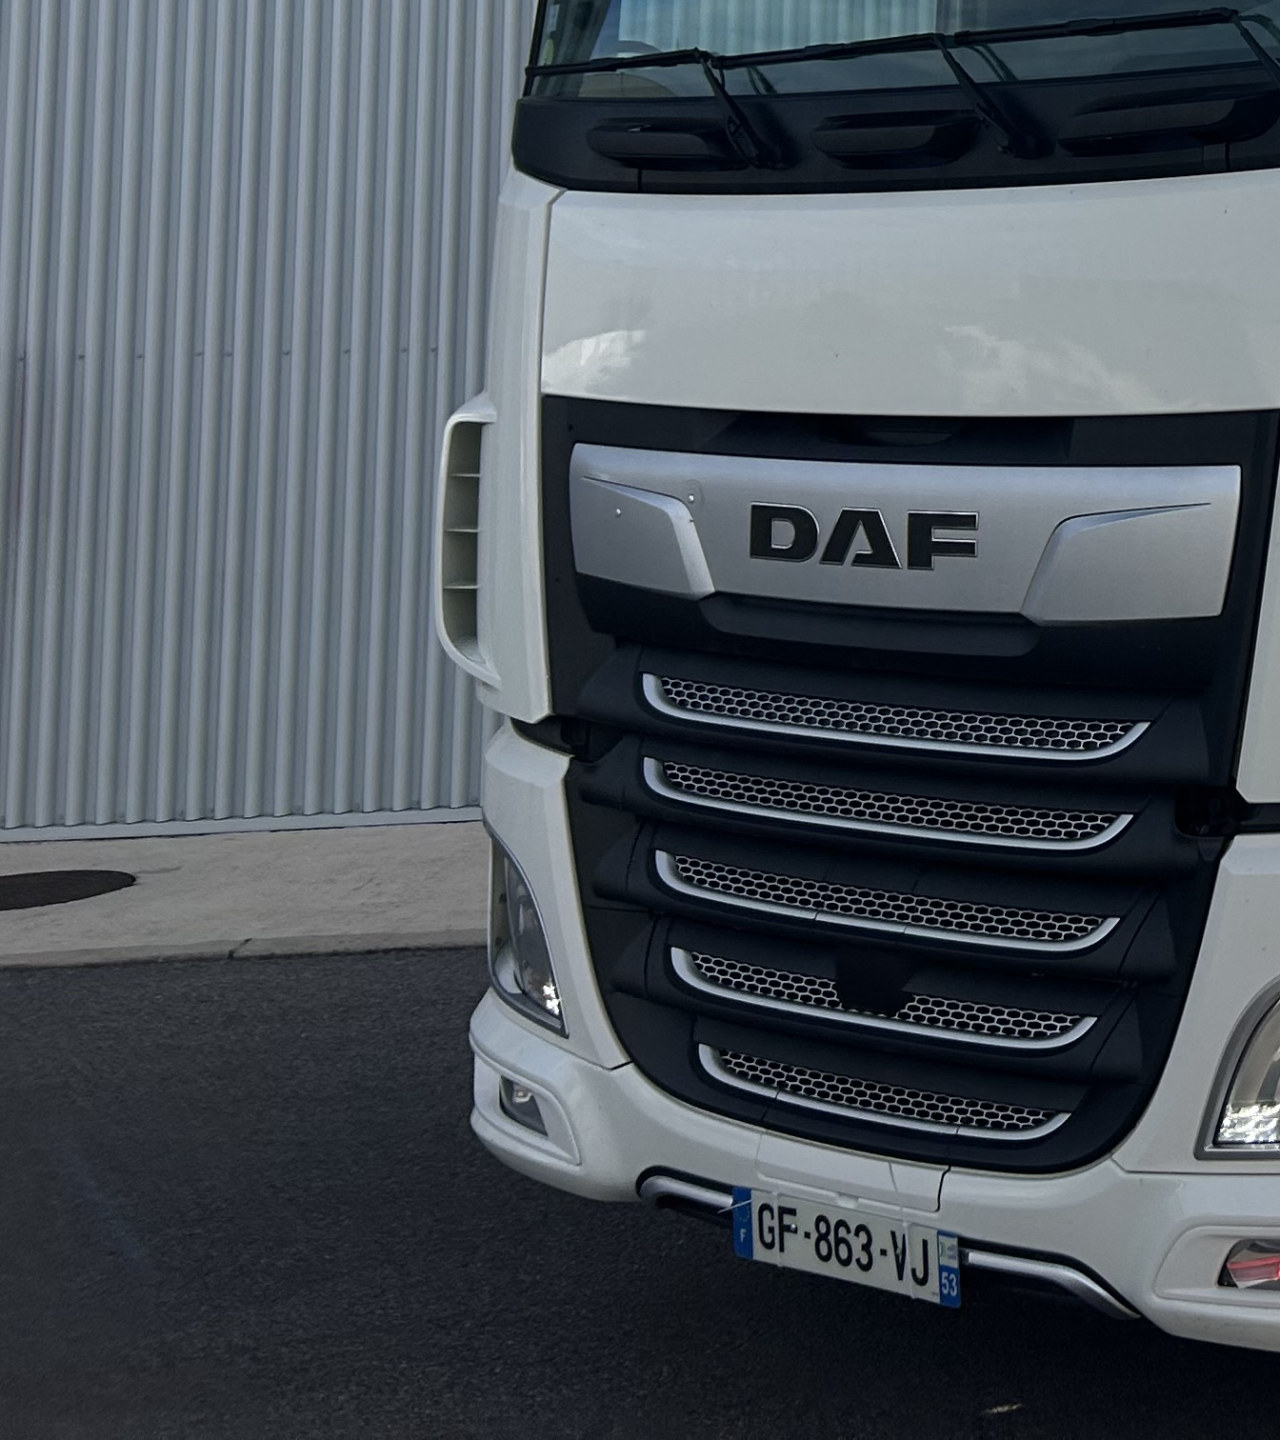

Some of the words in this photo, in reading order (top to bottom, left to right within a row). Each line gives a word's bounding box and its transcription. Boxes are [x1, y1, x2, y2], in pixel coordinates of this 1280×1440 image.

[748, 503, 980, 572] DAF
[757, 1202, 930, 1287] GF-863-VJ
[941, 1271, 958, 1297] 53
